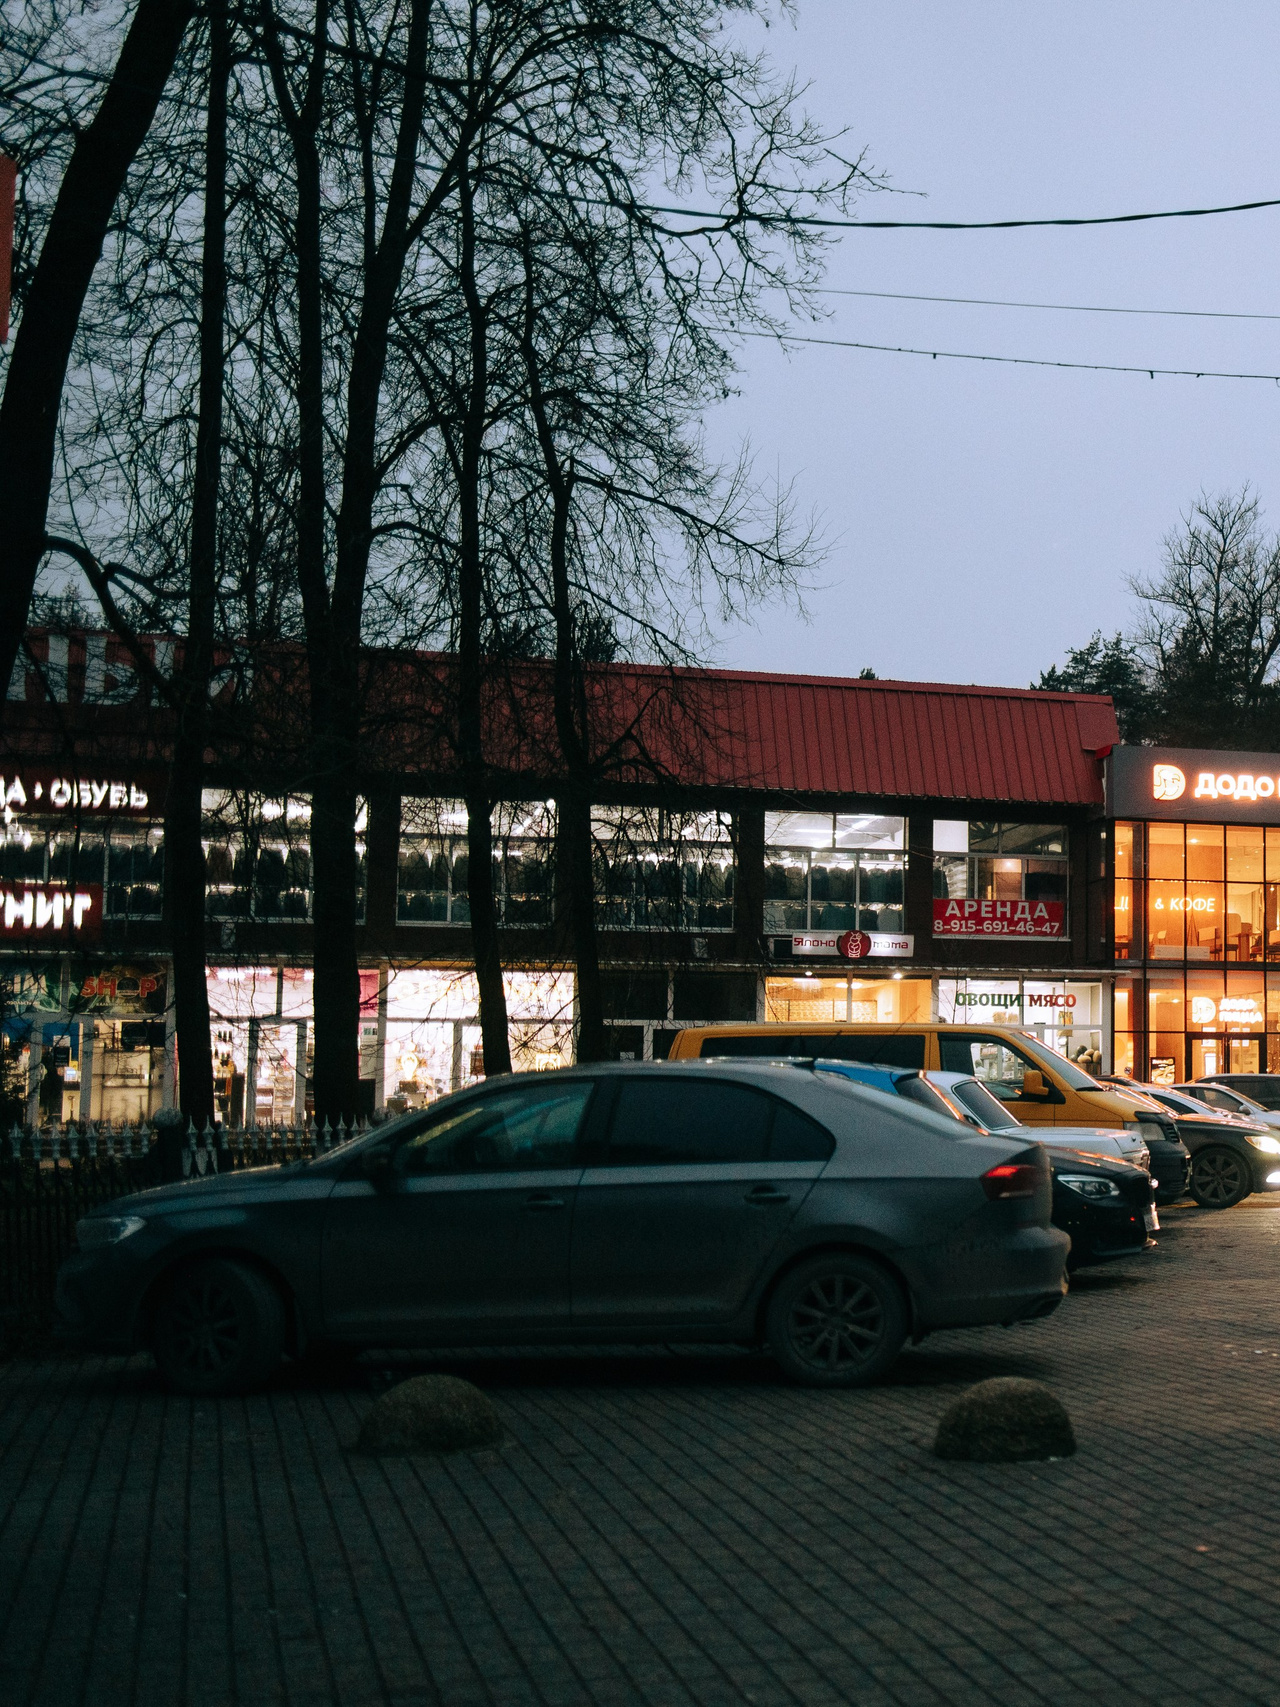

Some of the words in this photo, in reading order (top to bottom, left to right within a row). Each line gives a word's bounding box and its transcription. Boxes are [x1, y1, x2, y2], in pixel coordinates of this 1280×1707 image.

[50, 778, 149, 809] ОБУВЬ
[1194, 773, 1275, 800] ДОДО
[0, 890, 92, 930] НИТ
[945, 900, 1049, 921] АРЕНДА
[1170, 897, 1216, 912] КОФЕ
[933, 919, 1060, 934] 8-915-691-46-47
[955, 992, 1021, 1009] ОВОЩИ
[1028, 993, 1077, 1008] МЯСО
